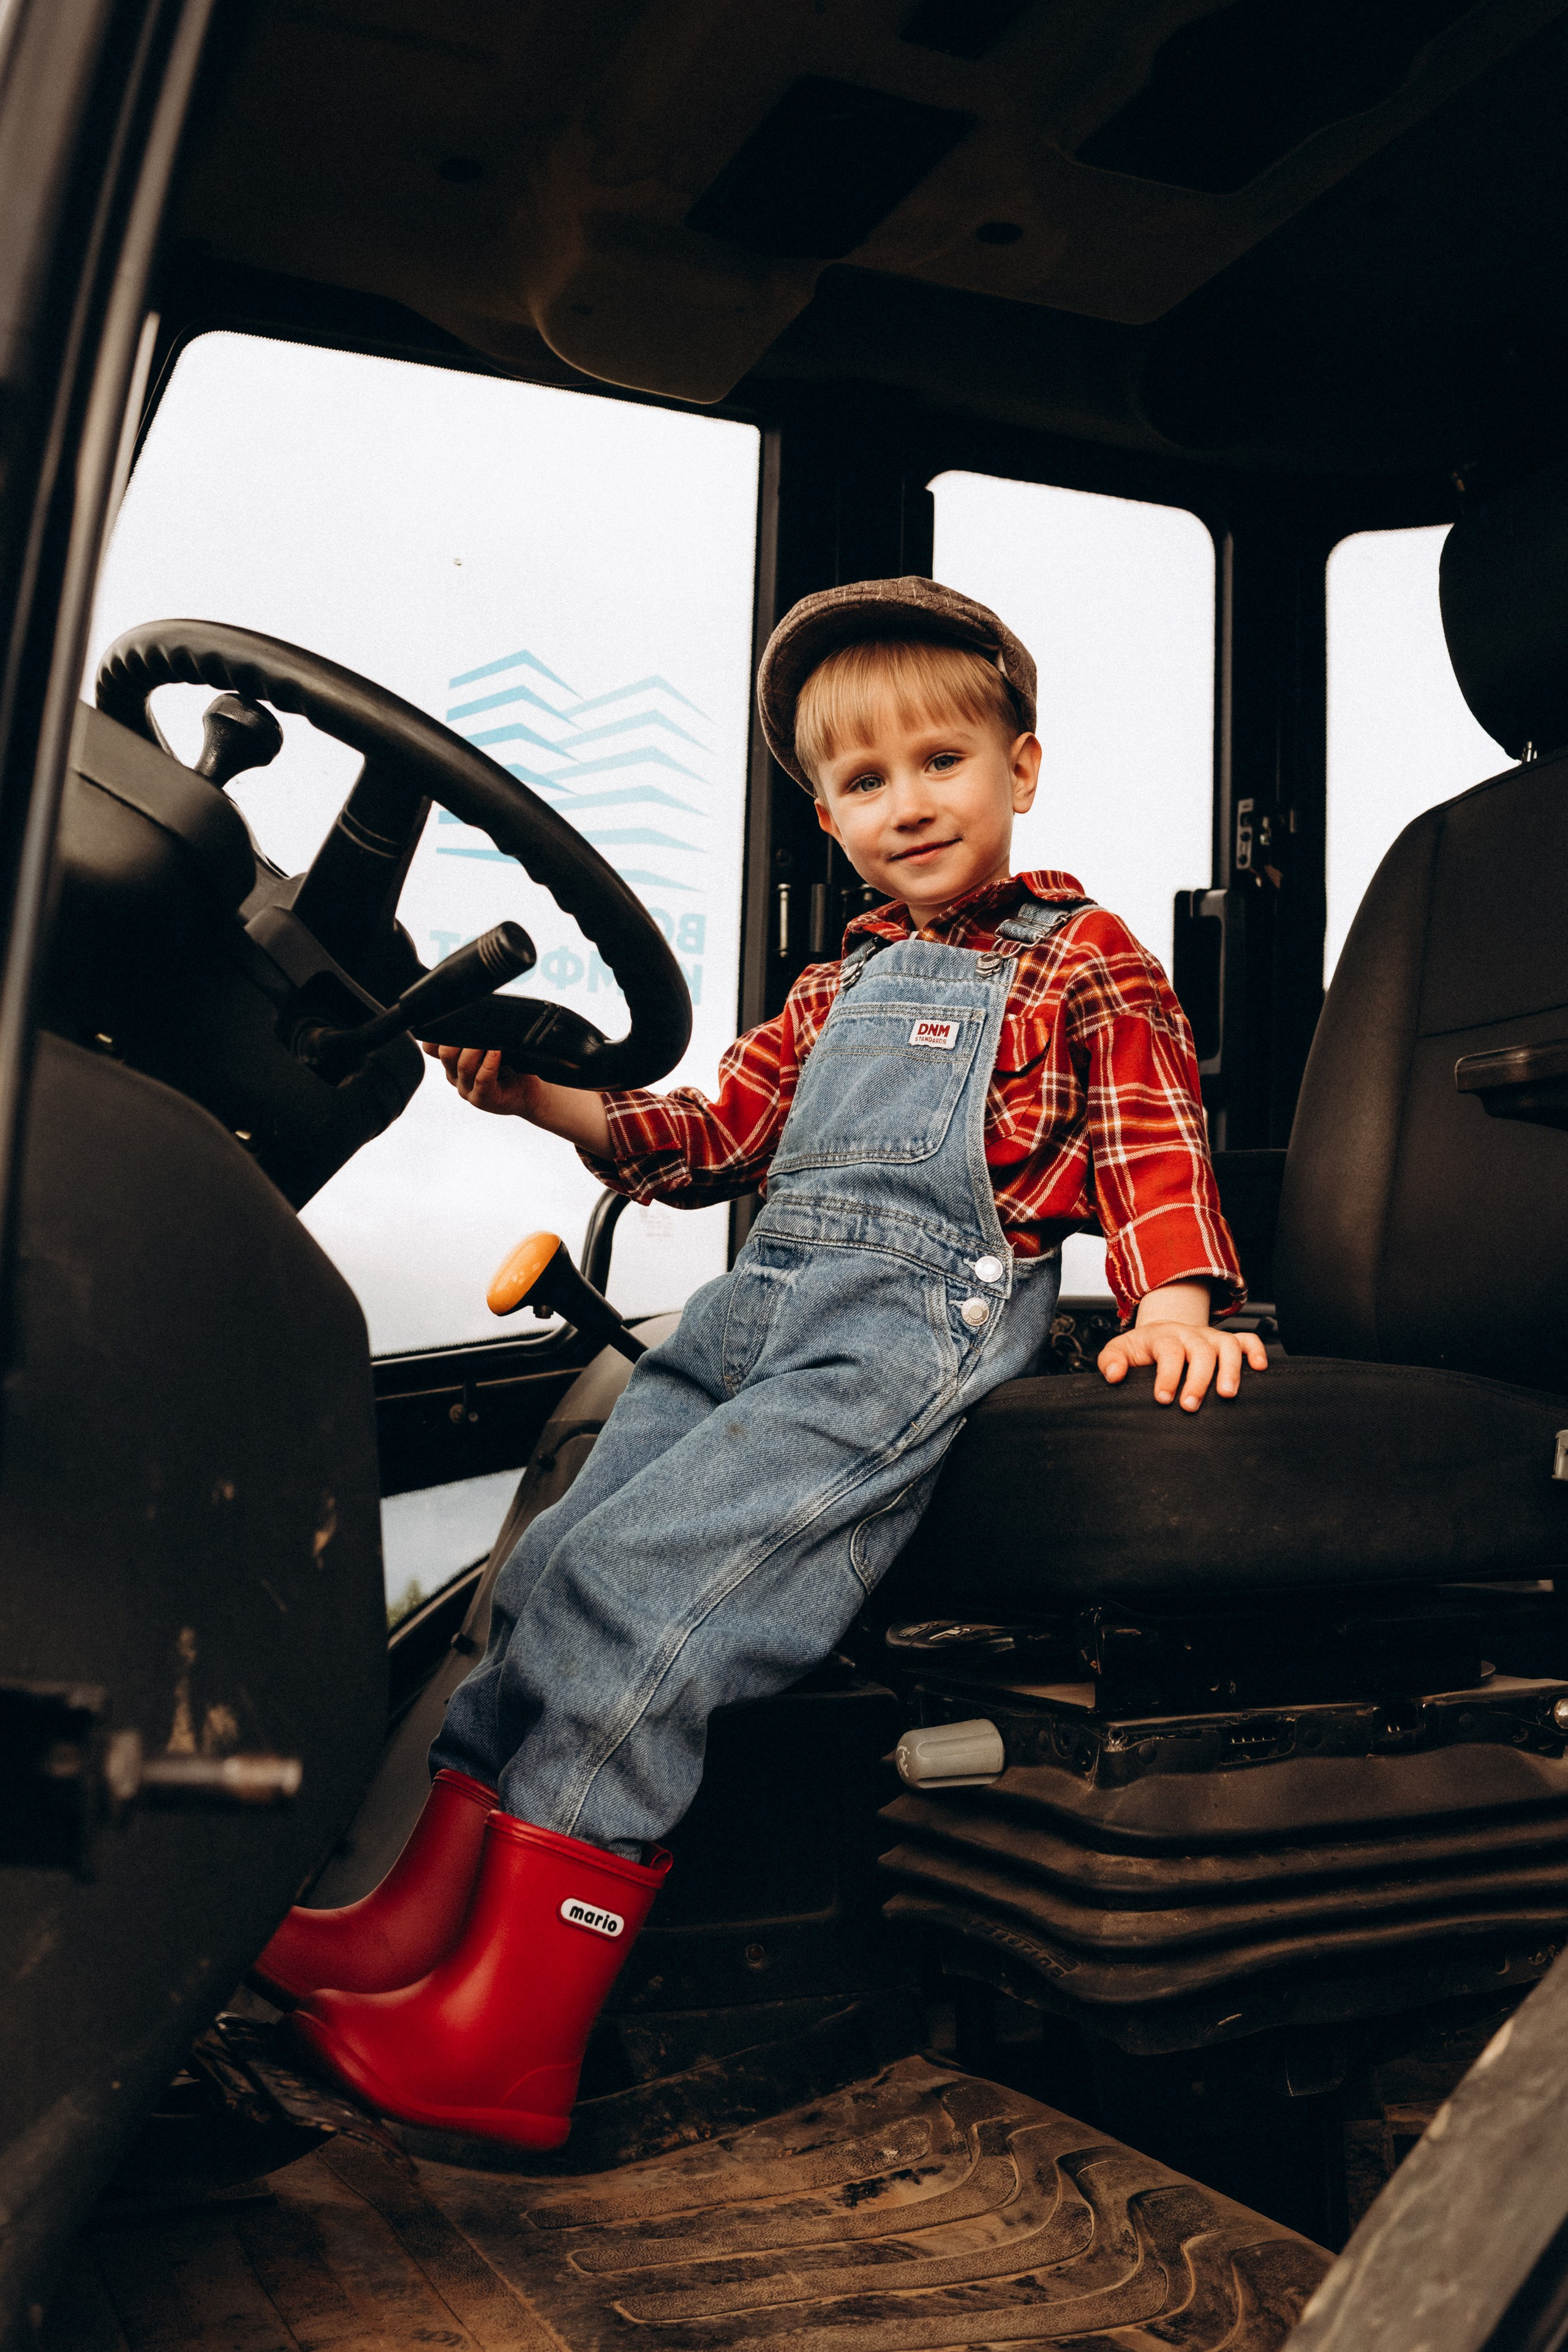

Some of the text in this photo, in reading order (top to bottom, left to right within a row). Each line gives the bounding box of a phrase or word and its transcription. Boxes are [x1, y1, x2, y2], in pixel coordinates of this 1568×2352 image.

[917, 1023, 951, 1038] DNM
[914, 1036, 947, 1045] STANDARDS
[569, 1905, 617, 1932] mario
